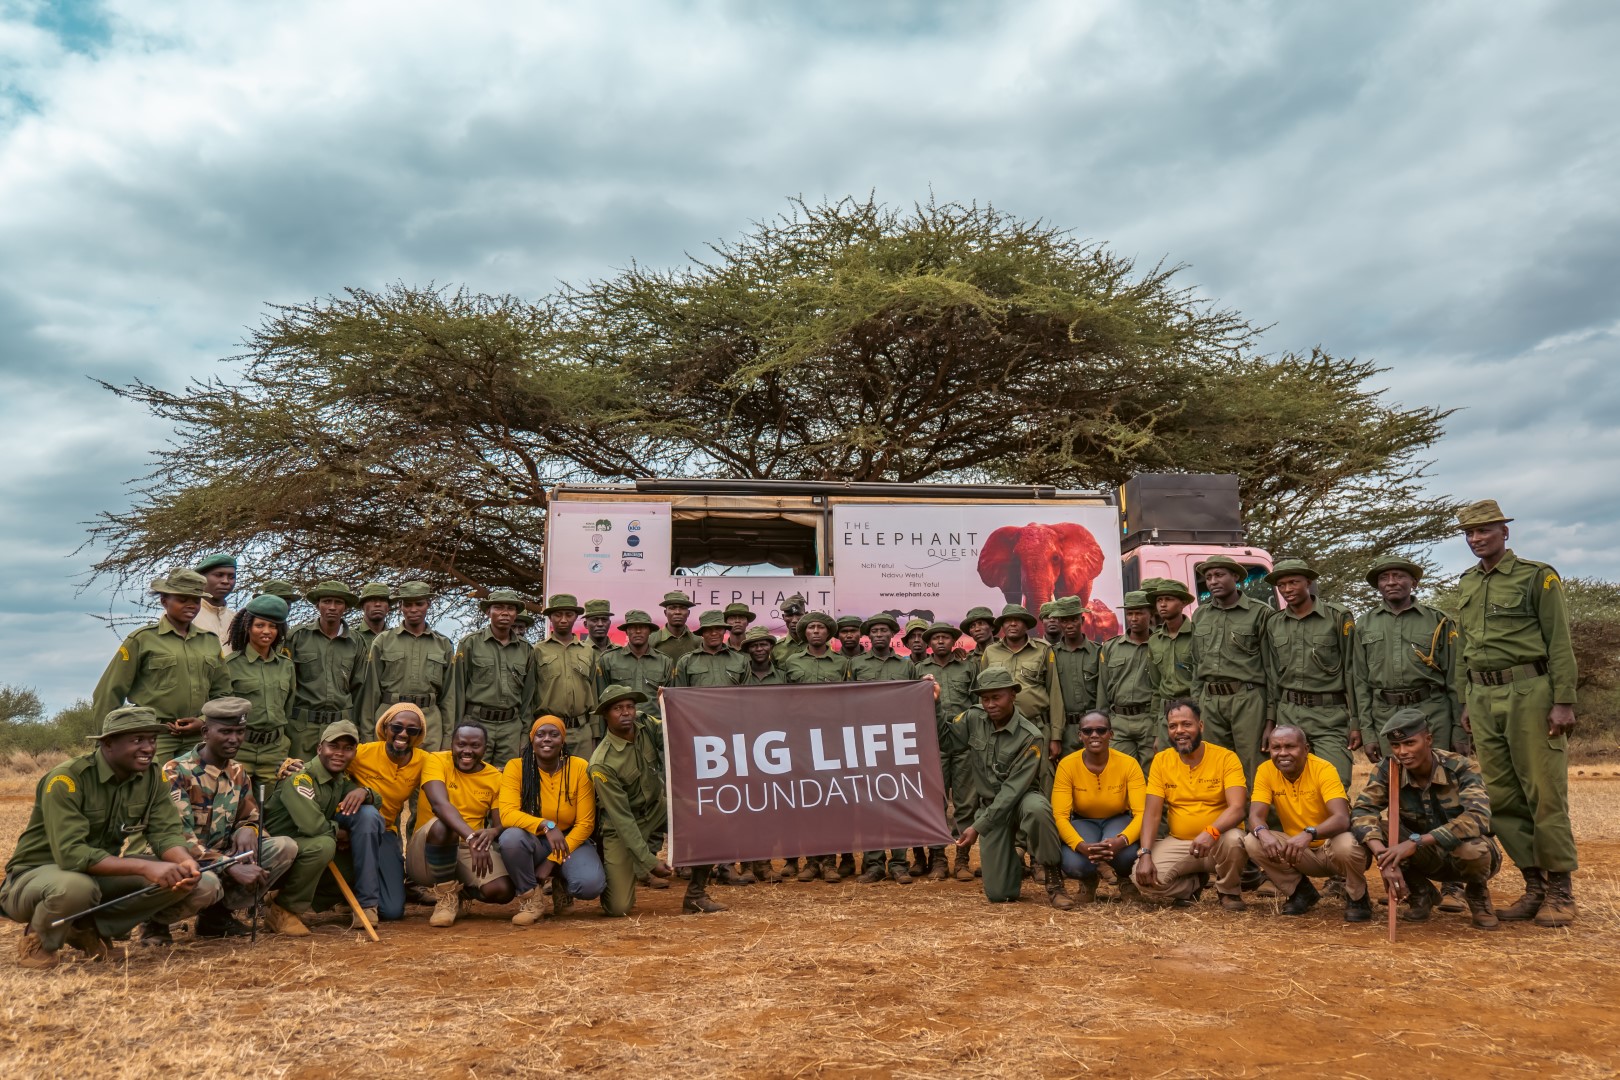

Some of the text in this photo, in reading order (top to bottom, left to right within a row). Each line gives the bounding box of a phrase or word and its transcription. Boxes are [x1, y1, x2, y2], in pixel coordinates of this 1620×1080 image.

[844, 532, 978, 546] ELEPHANT
[927, 548, 978, 557] QUEEN
[674, 578, 703, 587] THE
[674, 590, 831, 606] LEPHANT
[693, 722, 920, 780] BIG LIFE
[697, 771, 924, 816] FOUNDATION
